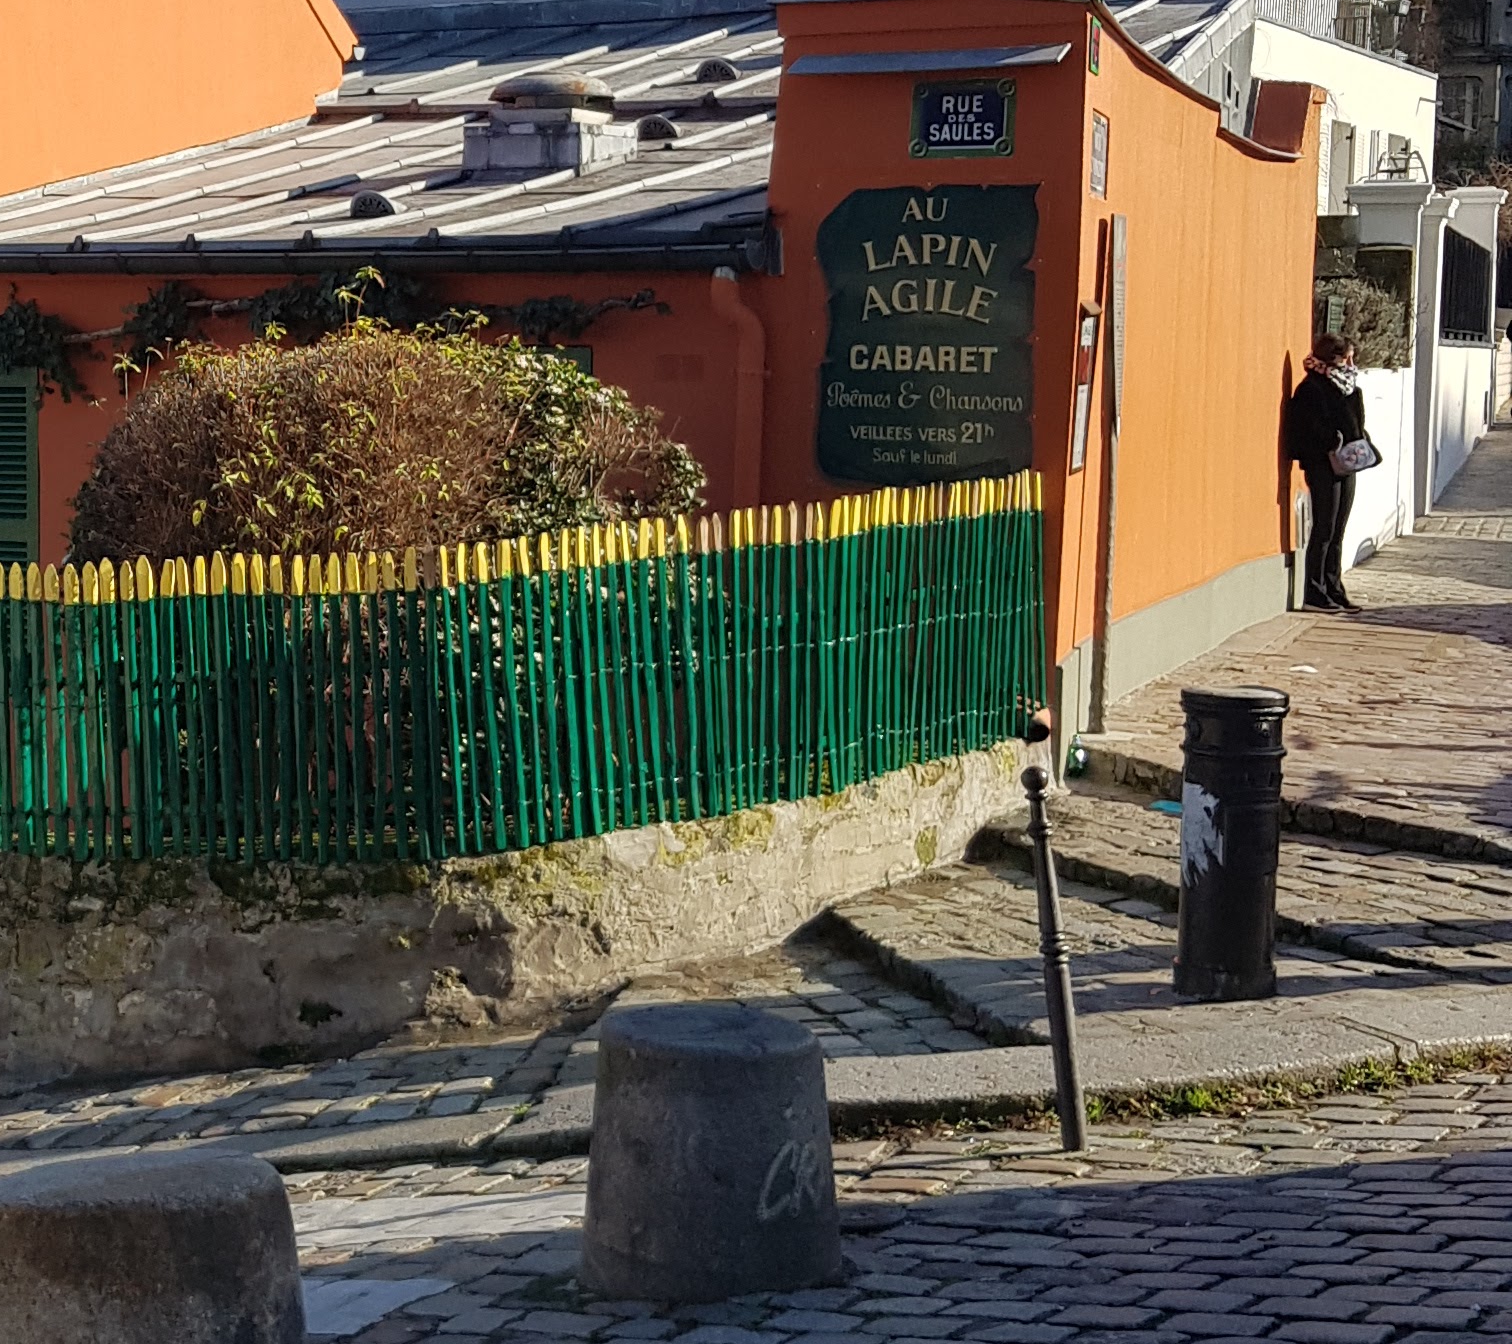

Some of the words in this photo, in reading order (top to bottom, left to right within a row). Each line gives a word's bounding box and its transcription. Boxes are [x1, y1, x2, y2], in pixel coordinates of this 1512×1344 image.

[941, 94, 984, 114] RUE
[948, 113, 976, 123] DES
[928, 122, 995, 142] SAULES
[901, 197, 949, 223] AU
[862, 233, 998, 277] LAPIN
[861, 278, 999, 324] AGILE
[849, 344, 999, 374] CABARET
[897, 381, 922, 409] &
[929, 385, 1024, 412] Chansons
[918, 427, 957, 443] VERS
[872, 447, 906, 463] Sauf
[910, 450, 921, 464] le
